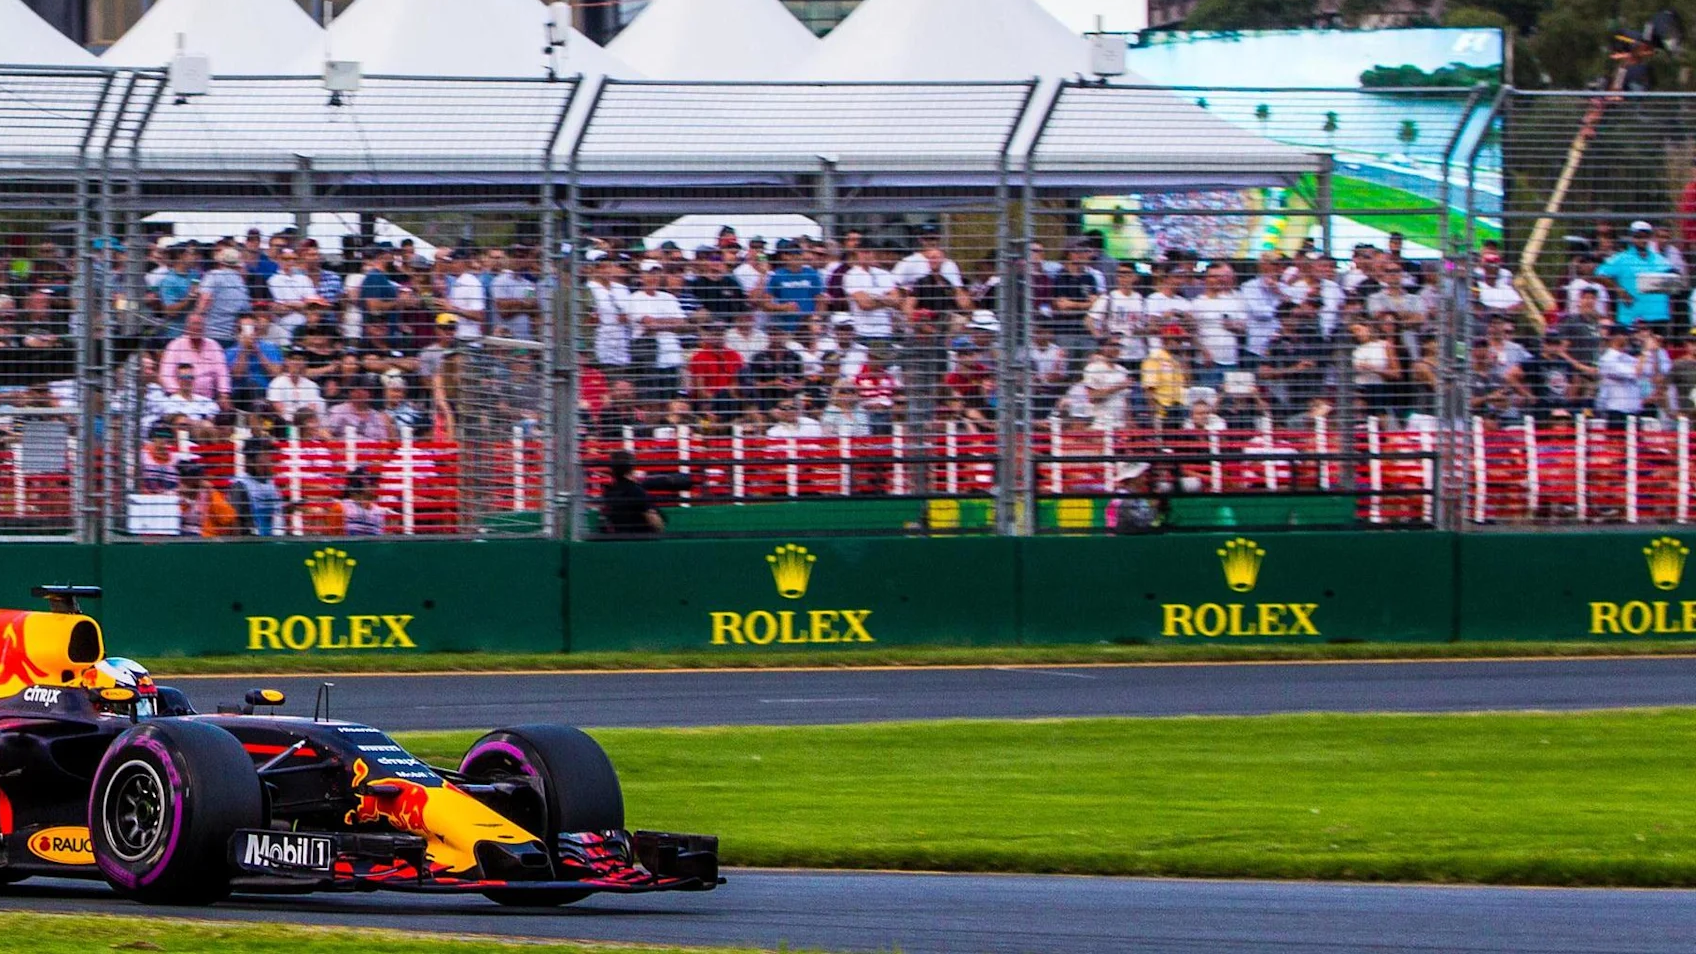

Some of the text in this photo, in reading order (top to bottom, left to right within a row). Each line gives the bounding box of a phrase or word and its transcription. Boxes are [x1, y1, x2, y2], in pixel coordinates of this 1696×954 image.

[247, 614, 416, 649] ROLEX
[710, 609, 874, 645] ROLEX
[1161, 602, 1320, 637] ROLEX
[1589, 601, 1696, 634] ROLE
[53, 837, 93, 853] RAUC
[244, 833, 308, 867] Mobil
